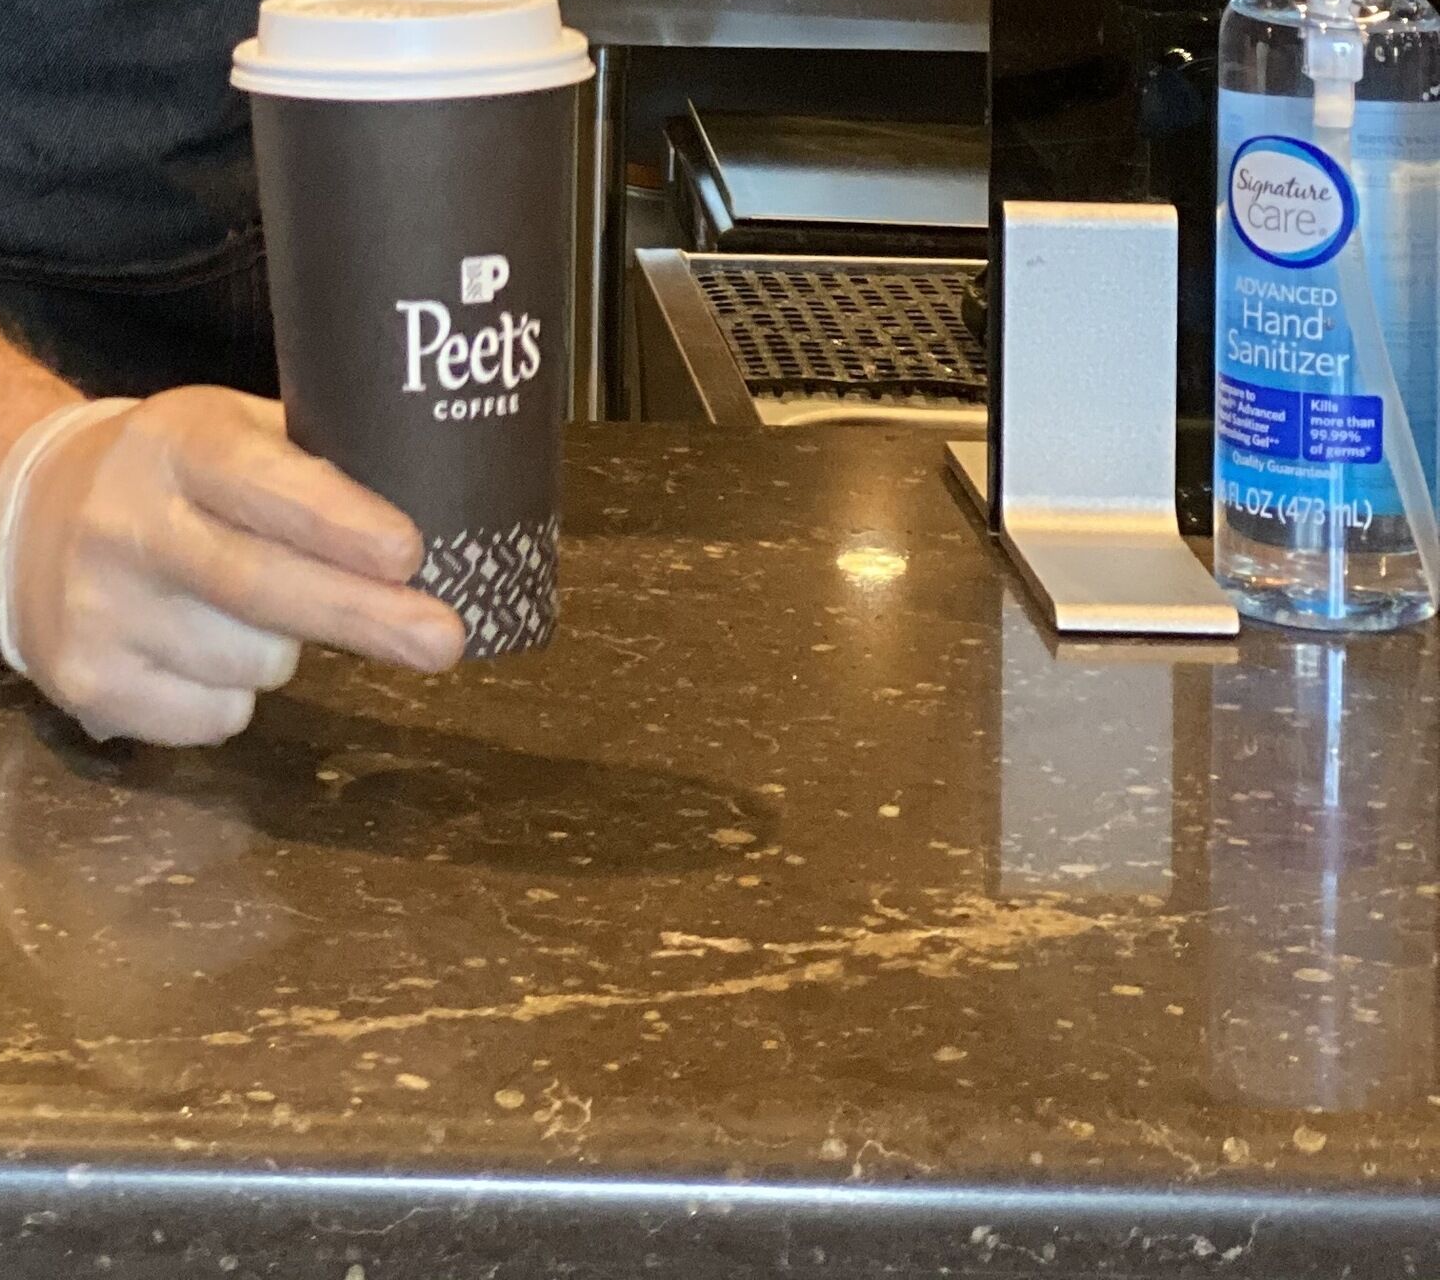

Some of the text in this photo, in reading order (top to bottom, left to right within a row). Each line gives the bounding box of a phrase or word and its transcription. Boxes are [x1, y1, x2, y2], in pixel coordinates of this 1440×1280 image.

[1236, 167, 1332, 202] Signature
[1235, 275, 1338, 307] ADVANCED
[1242, 297, 1324, 341] Hand
[396, 300, 541, 392] Peet's
[1228, 328, 1350, 377] Sanitizer
[433, 392, 520, 422] COFFEE
[1238, 401, 1287, 422] Advanced
[1310, 399, 1339, 413] Kills
[1310, 415, 1376, 429] more than
[1309, 429, 1362, 443] 99.99%
[1309, 442, 1324, 455] of
[1232, 448, 1338, 480] Quality Guaranteed
[1246, 486, 1274, 519] OZ
[1278, 493, 1327, 526] (473
